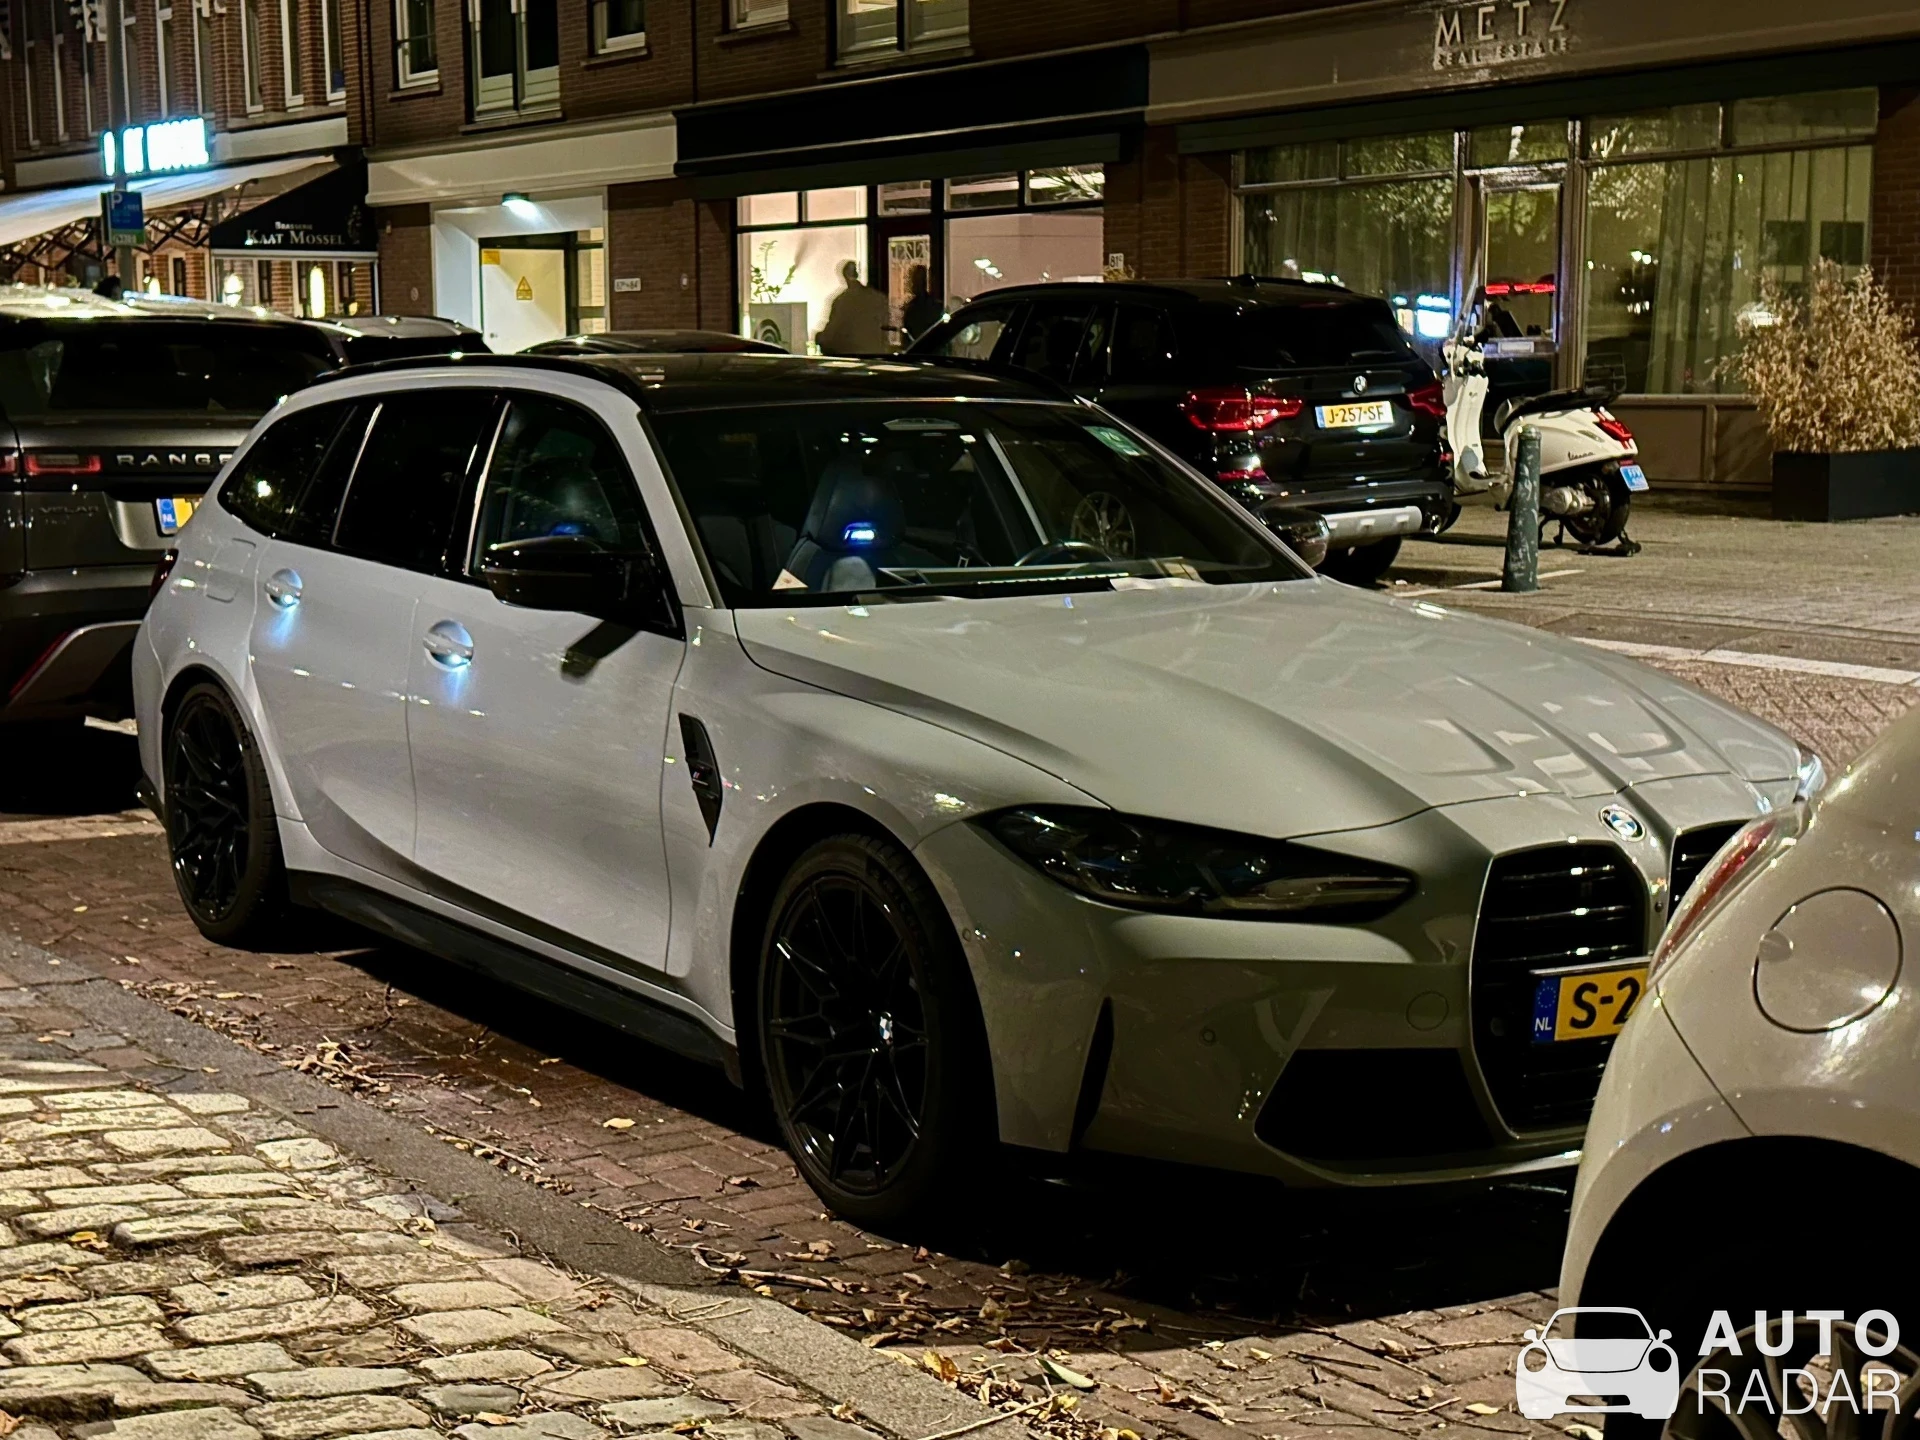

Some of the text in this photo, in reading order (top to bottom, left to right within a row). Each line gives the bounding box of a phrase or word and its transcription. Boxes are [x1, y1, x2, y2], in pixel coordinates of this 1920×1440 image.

[1435, 0, 1567, 48] METZ
[1434, 38, 1567, 67] REAL ESTATE
[245, 229, 346, 246] KAAT MOSSEL
[1328, 404, 1385, 424] J-257-SF
[162, 513, 175, 523] NL
[1534, 1016, 1553, 1031] NL
